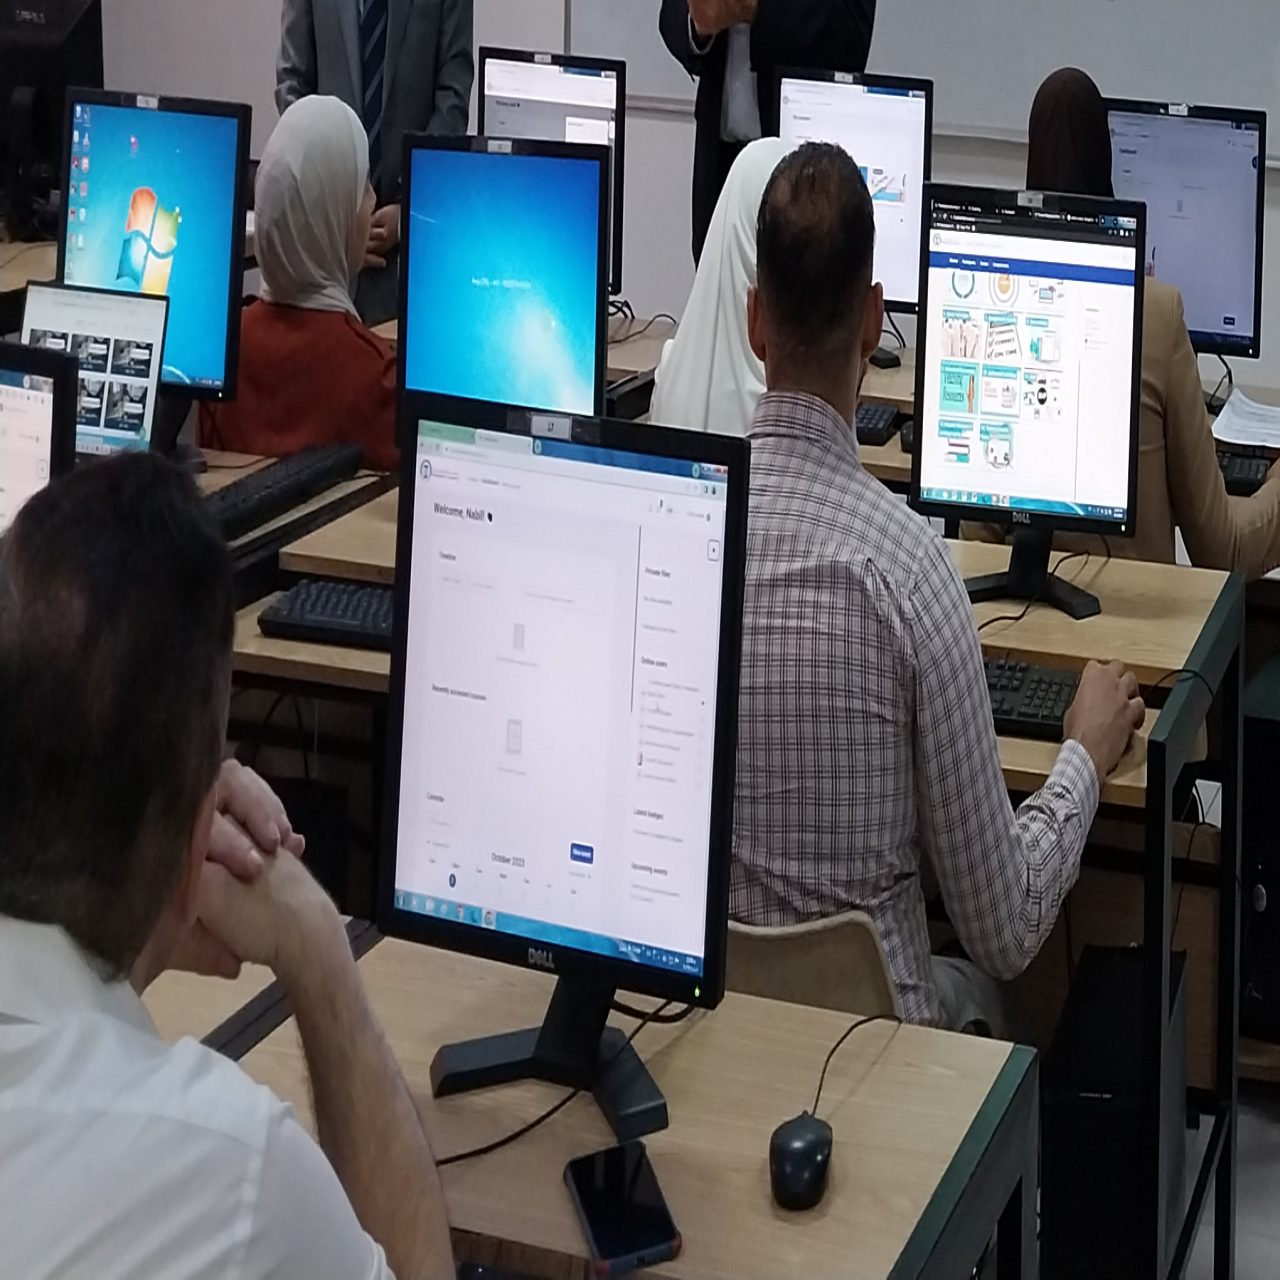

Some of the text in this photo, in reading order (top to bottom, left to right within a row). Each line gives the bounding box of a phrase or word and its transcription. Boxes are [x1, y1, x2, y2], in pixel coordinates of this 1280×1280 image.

[433, 502, 464, 519] Welcome,
[1012, 511, 1031, 524] DELL
[491, 851, 511, 866] October
[528, 947, 554, 968] DELL
